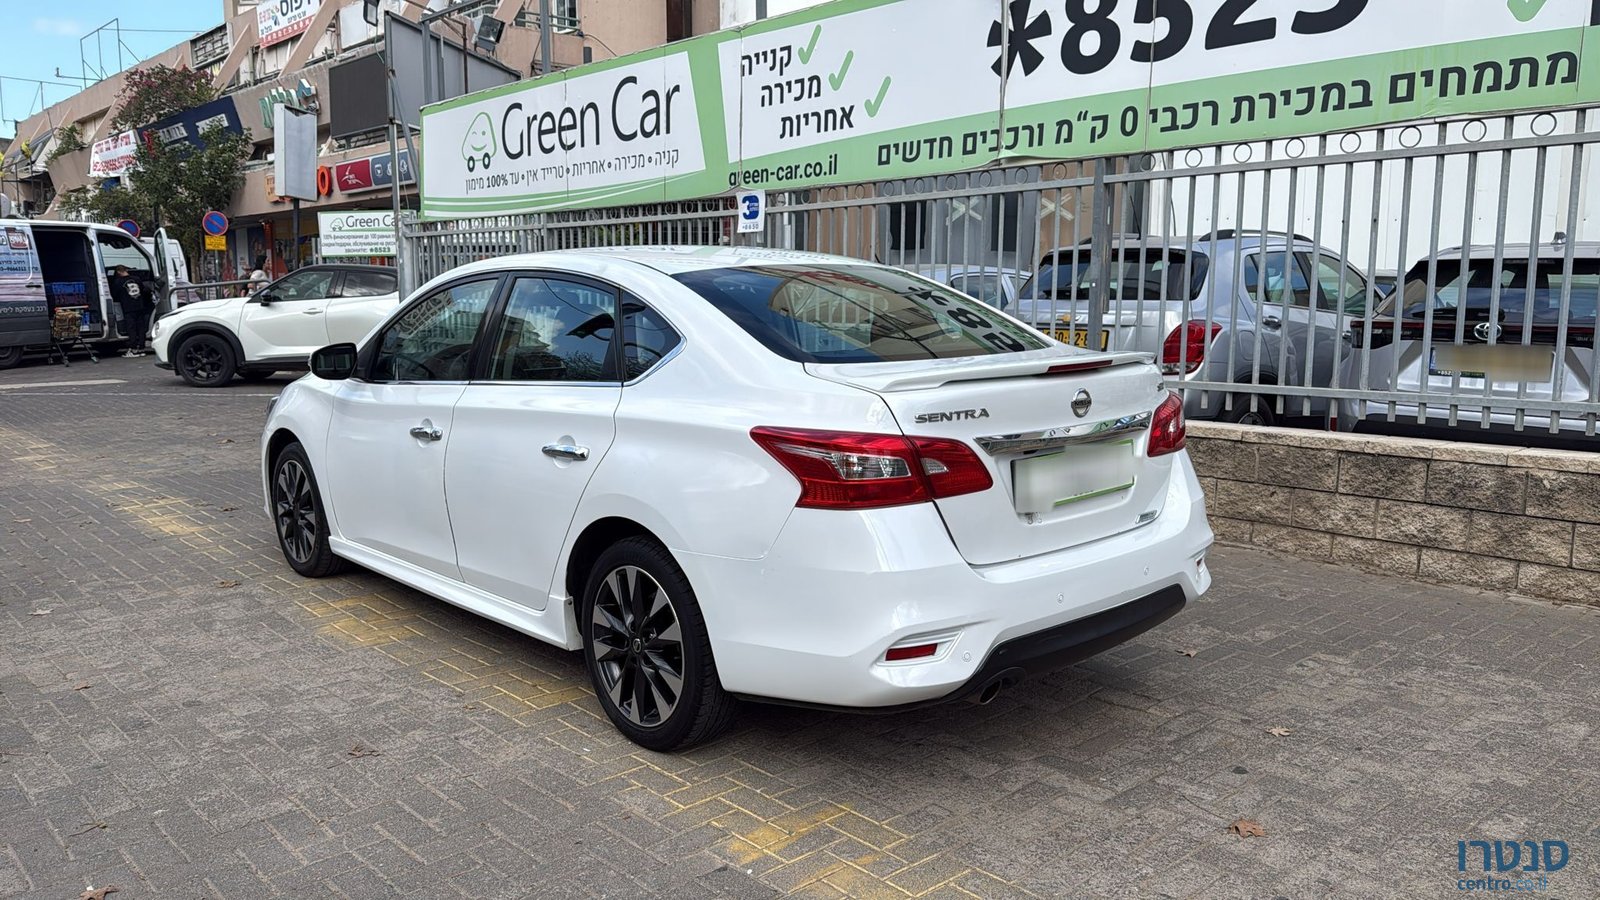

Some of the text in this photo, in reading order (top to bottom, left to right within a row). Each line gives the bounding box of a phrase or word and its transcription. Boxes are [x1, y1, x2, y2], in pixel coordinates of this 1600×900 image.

[741, 45, 792, 77] קנייה
[1388, 50, 1578, 105] מתמחים
[761, 75, 821, 107] מכירה
[1230, 78, 1373, 125] במכירת
[502, 76, 680, 160] Green Car
[779, 105, 855, 139] אחריות
[1149, 100, 1219, 133] רכבי
[877, 135, 953, 166] חדשים
[962, 122, 1045, 156] ורכבים
[465, 149, 679, 195] קניה מכירה אחריות טרייד אין עד 100% מימון
[346, 214, 396, 228] Green Ca
[914, 407, 990, 424] SENTRA
